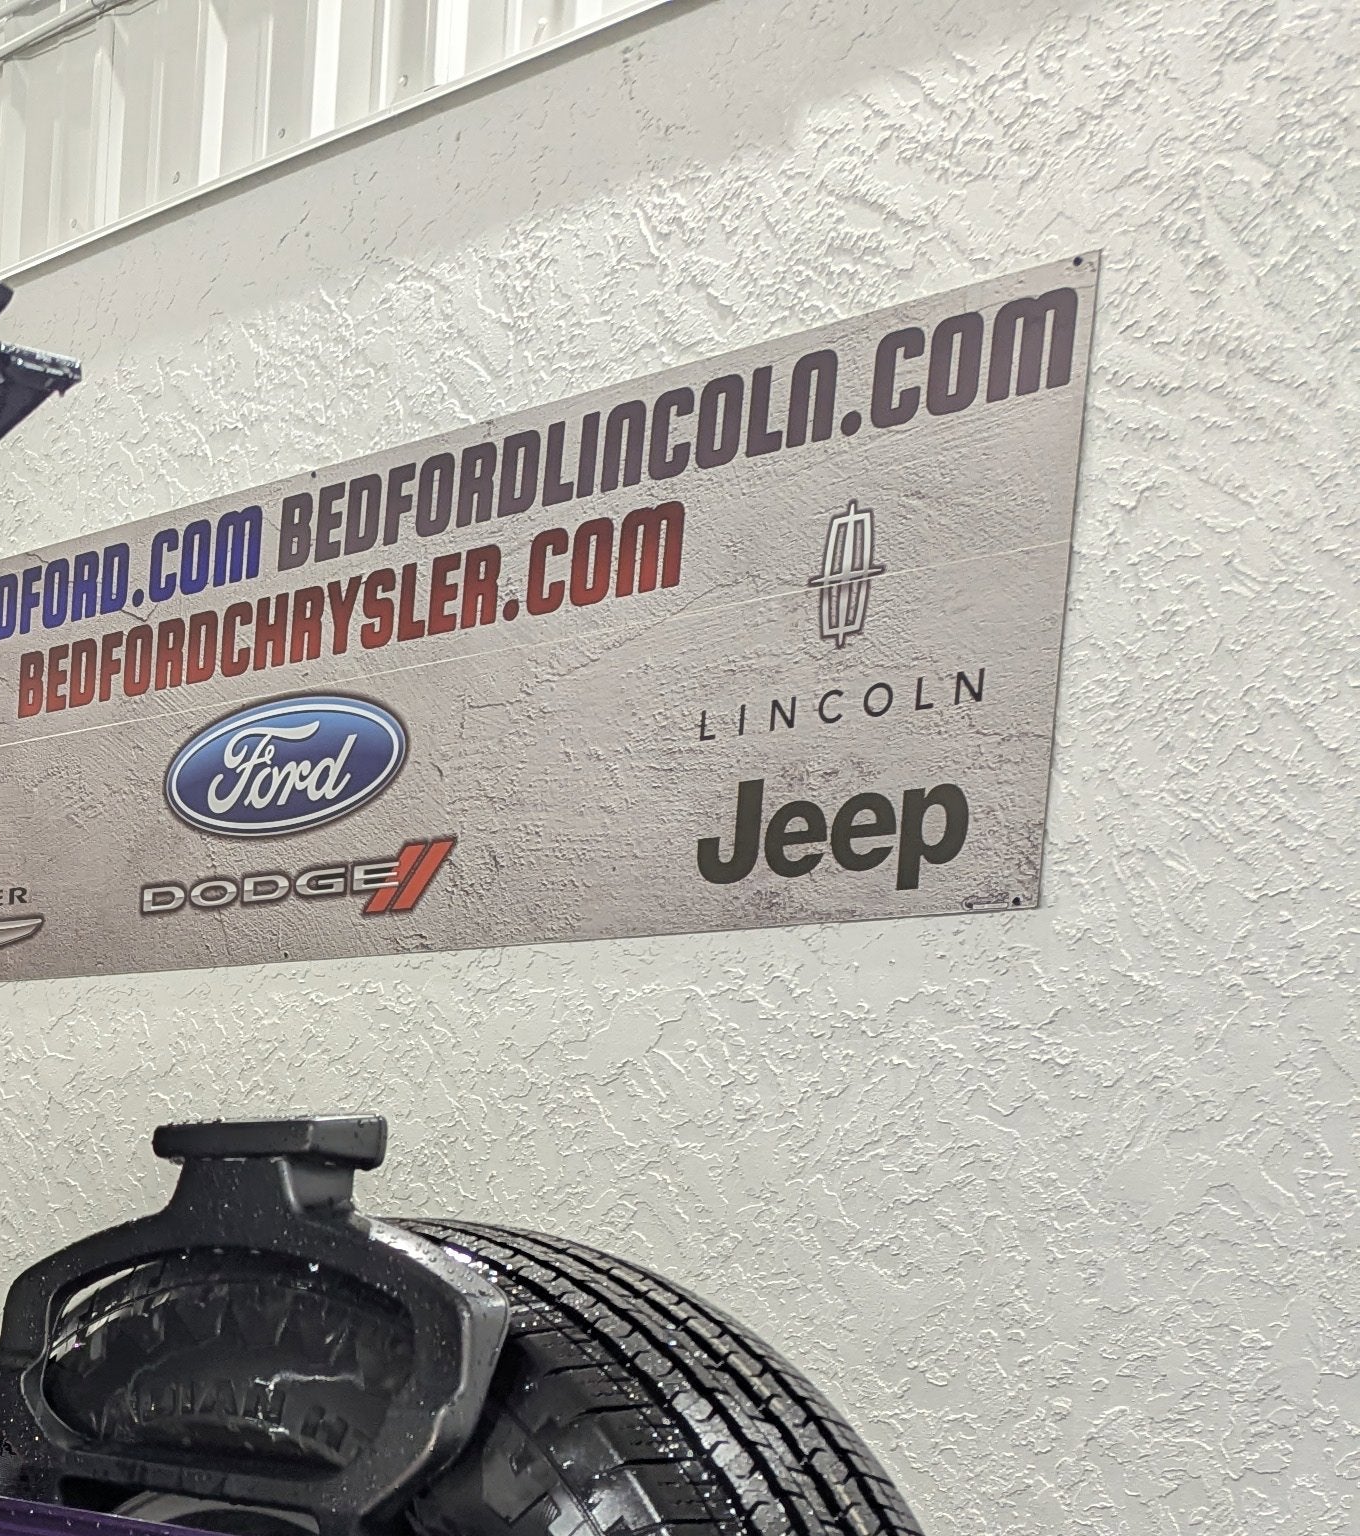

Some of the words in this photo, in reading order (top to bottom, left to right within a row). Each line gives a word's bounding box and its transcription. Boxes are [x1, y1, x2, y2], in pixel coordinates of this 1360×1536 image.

[278, 287, 1078, 572] BEDFORDLINCOLN.COM
[18, 501, 685, 719] BEDFORDCHRYSLER.COM
[700, 668, 985, 741] LINCOLN
[207, 721, 359, 814] Ford
[697, 779, 969, 890] Jeep
[142, 861, 400, 913] DODGE
